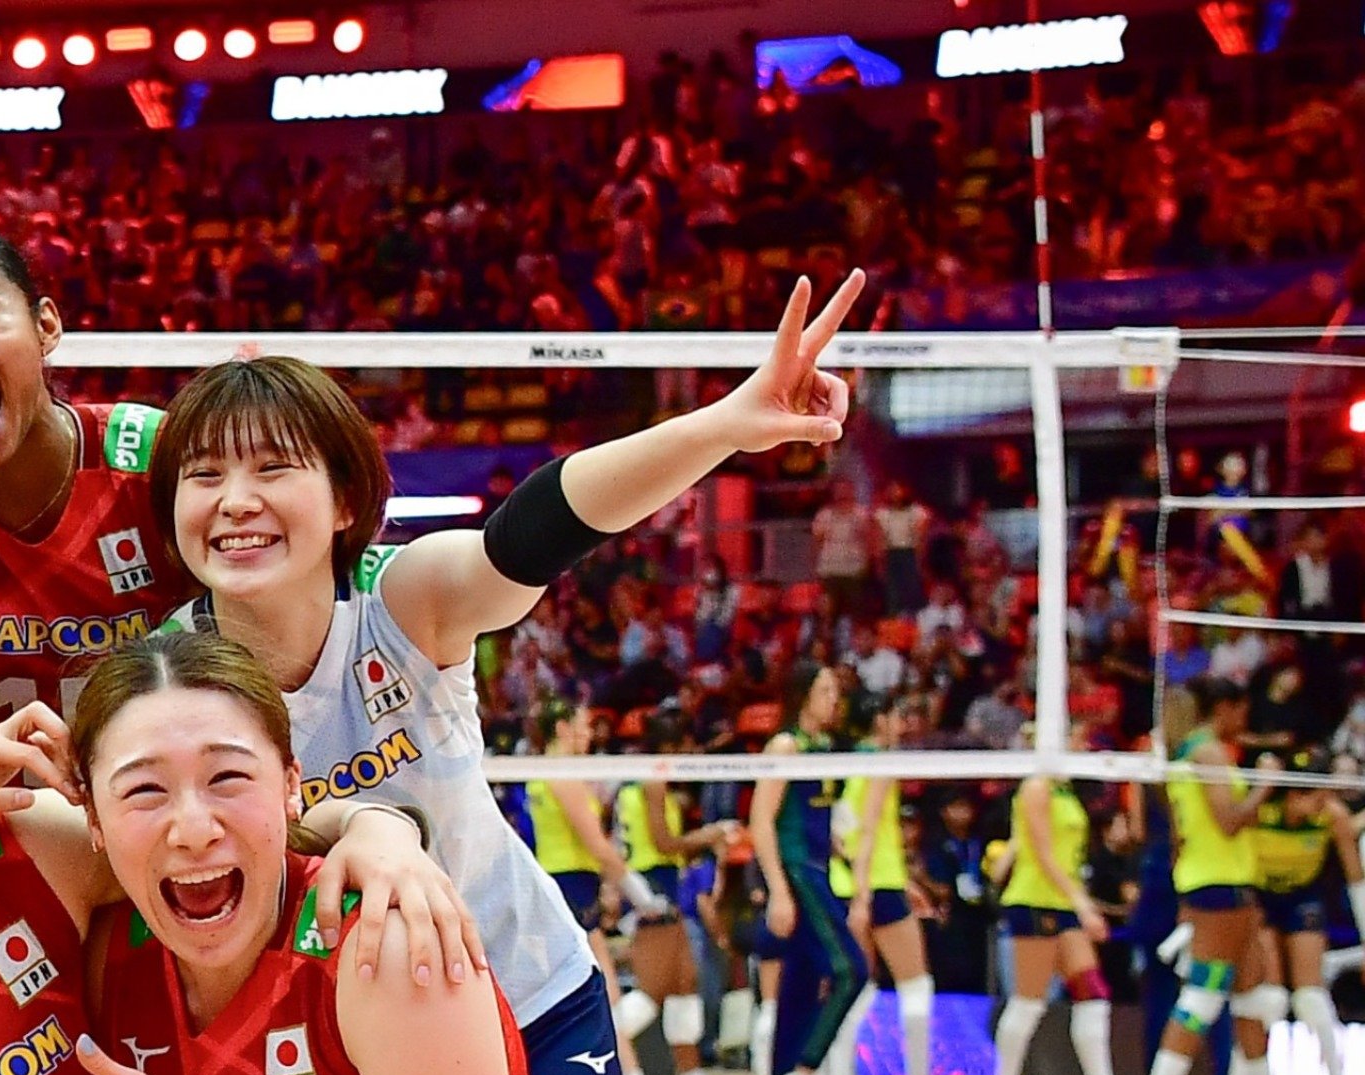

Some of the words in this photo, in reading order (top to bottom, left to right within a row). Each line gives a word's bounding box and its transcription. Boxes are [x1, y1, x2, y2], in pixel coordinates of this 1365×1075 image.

[529, 345, 604, 361] MIKASA
[118, 567, 155, 592] JPN
[372, 687, 411, 715] JPN
[299, 727, 422, 812] PCOM
[17, 960, 54, 998] JPN
